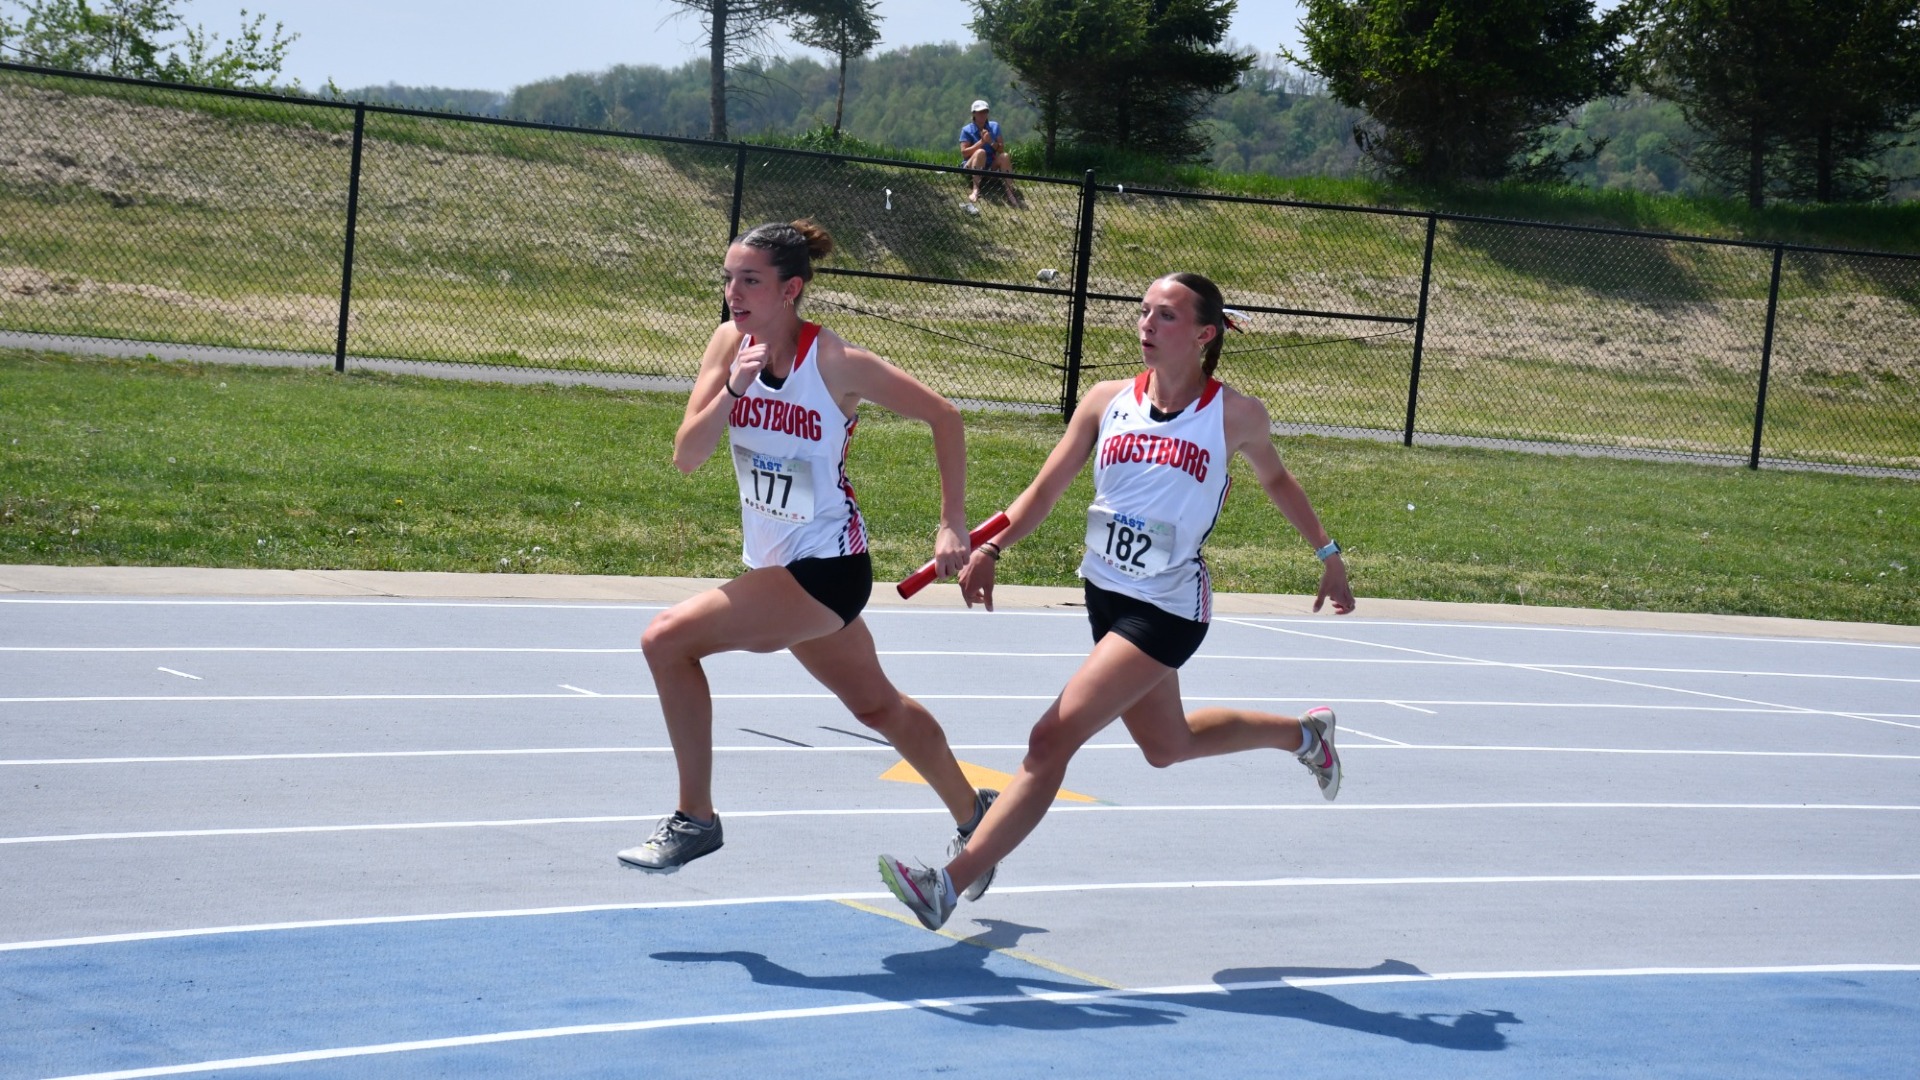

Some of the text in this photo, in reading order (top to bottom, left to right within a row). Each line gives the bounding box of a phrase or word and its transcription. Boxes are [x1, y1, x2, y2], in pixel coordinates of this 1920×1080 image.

[753, 458, 783, 472] EAST
[1100, 433, 1210, 483] FROSTBURG
[751, 469, 793, 509] 177
[1113, 513, 1145, 531] EAST
[1106, 521, 1152, 569] 182
